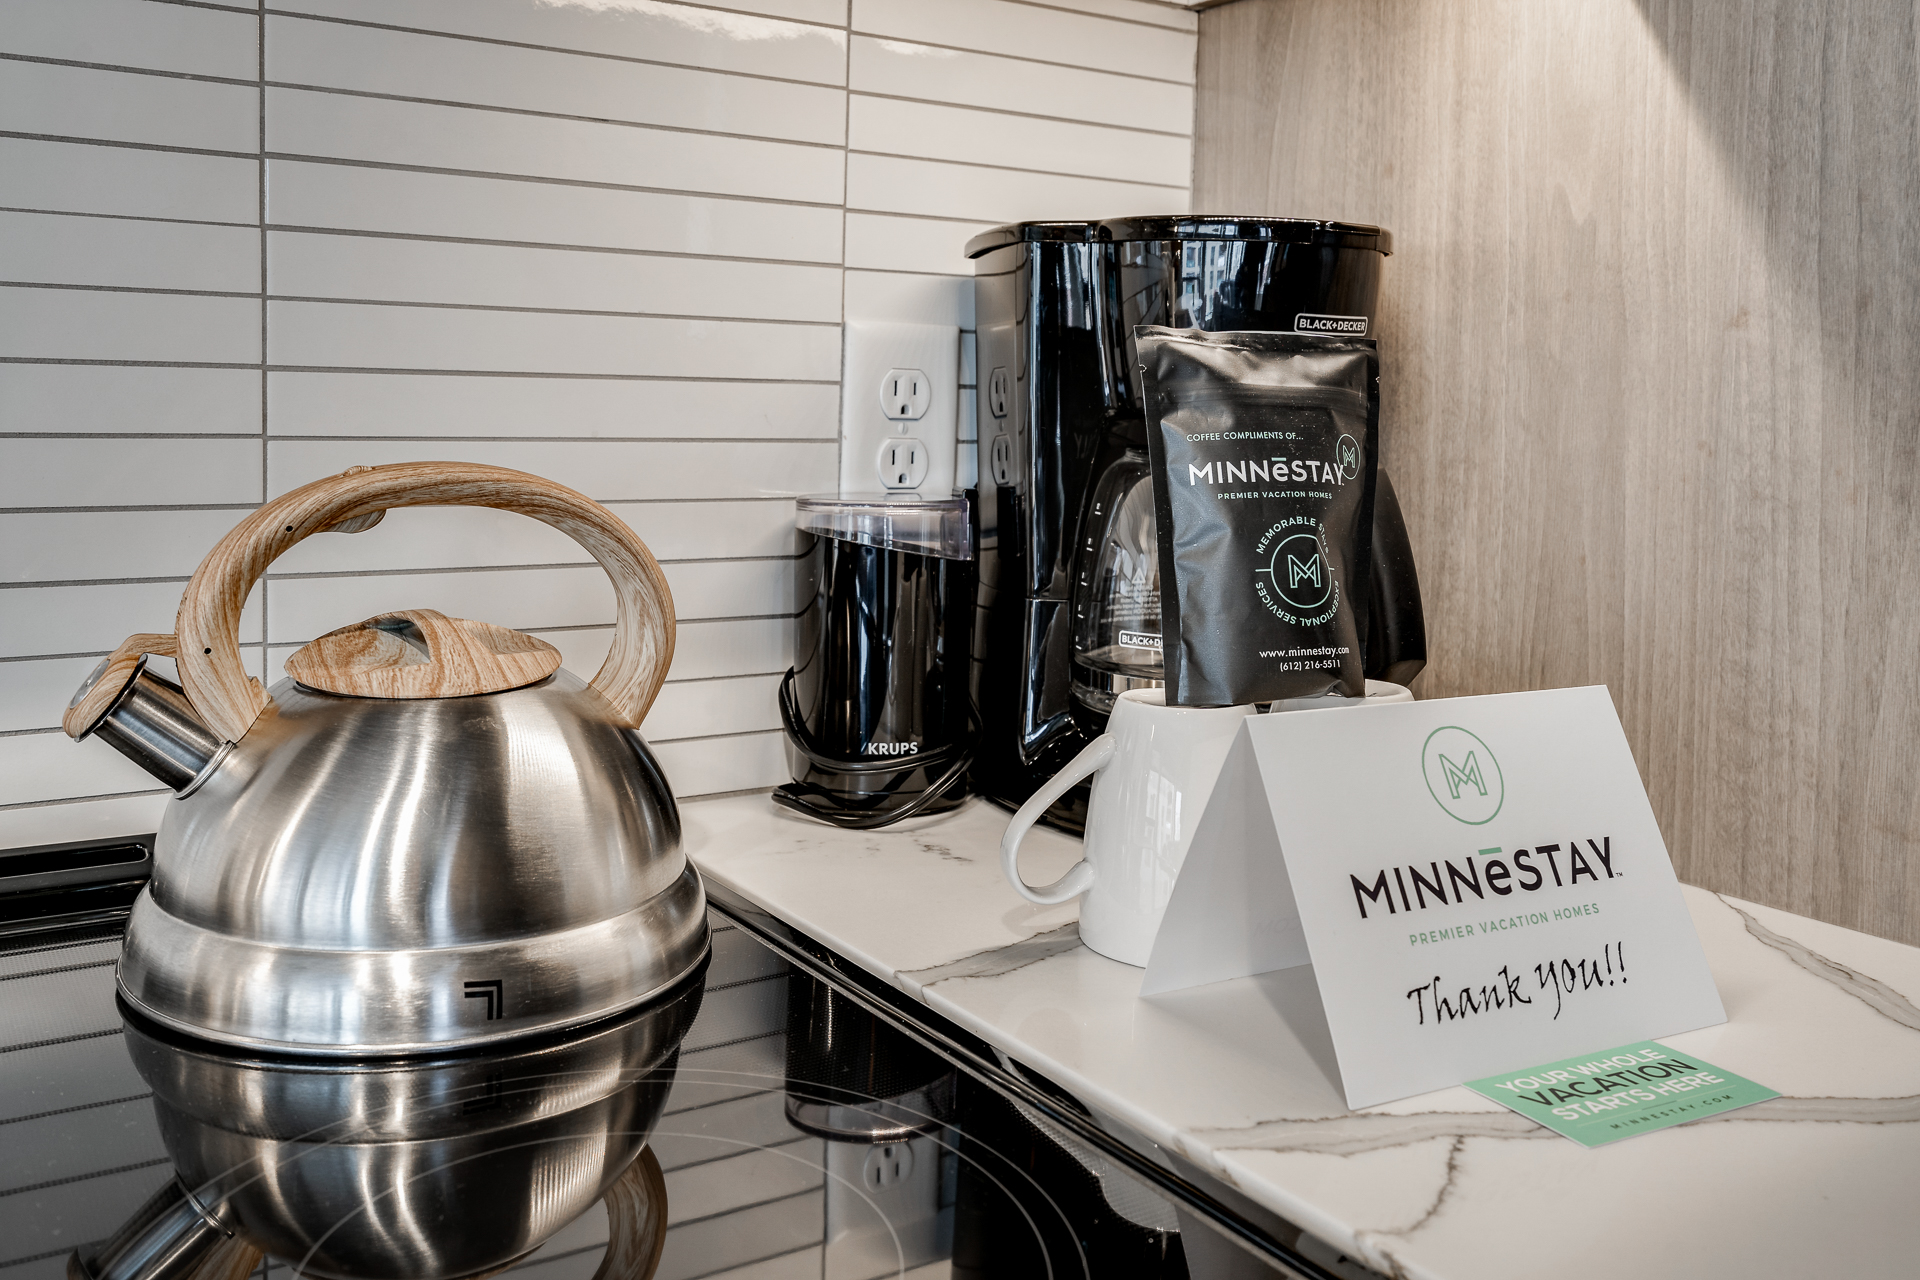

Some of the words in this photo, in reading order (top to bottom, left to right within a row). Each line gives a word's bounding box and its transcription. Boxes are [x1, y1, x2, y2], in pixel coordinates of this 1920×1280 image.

[1299, 318, 1366, 331] BLACK+DECKER
[1186, 433, 1221, 442] COFFEE
[1223, 431, 1284, 440] COMPLIMENTS
[1285, 432, 1304, 440] OF...
[1217, 491, 1259, 500] PREMIER
[1261, 490, 1306, 499] VACATION
[1308, 491, 1333, 500] HOMES
[1255, 516, 1316, 554] MEMORABLE
[1255, 581, 1297, 625] SERVICES
[1300, 580, 1341, 627] EXCEPTIONAL
[1121, 634, 1164, 647] BLACK+D
[1279, 661, 1302, 673] (612)
[1304, 659, 1341, 670] 216-5511
[867, 741, 919, 756] KRUPS
[1409, 924, 1476, 947] PREMIER
[1479, 911, 1550, 935] VACATION
[1553, 902, 1601, 922] HOMES
[1406, 965, 1532, 1026] Thank
[1535, 941, 1628, 1021] you!!
[1494, 1070, 1578, 1093] YOUR
[1566, 1048, 1667, 1076] WHOLE
[1517, 1058, 1699, 1106] VACATION
[1551, 1088, 1657, 1121] STARTS
[1648, 1071, 1726, 1097] HERE
[1609, 1094, 1735, 1130] MINNESTAY.COM
